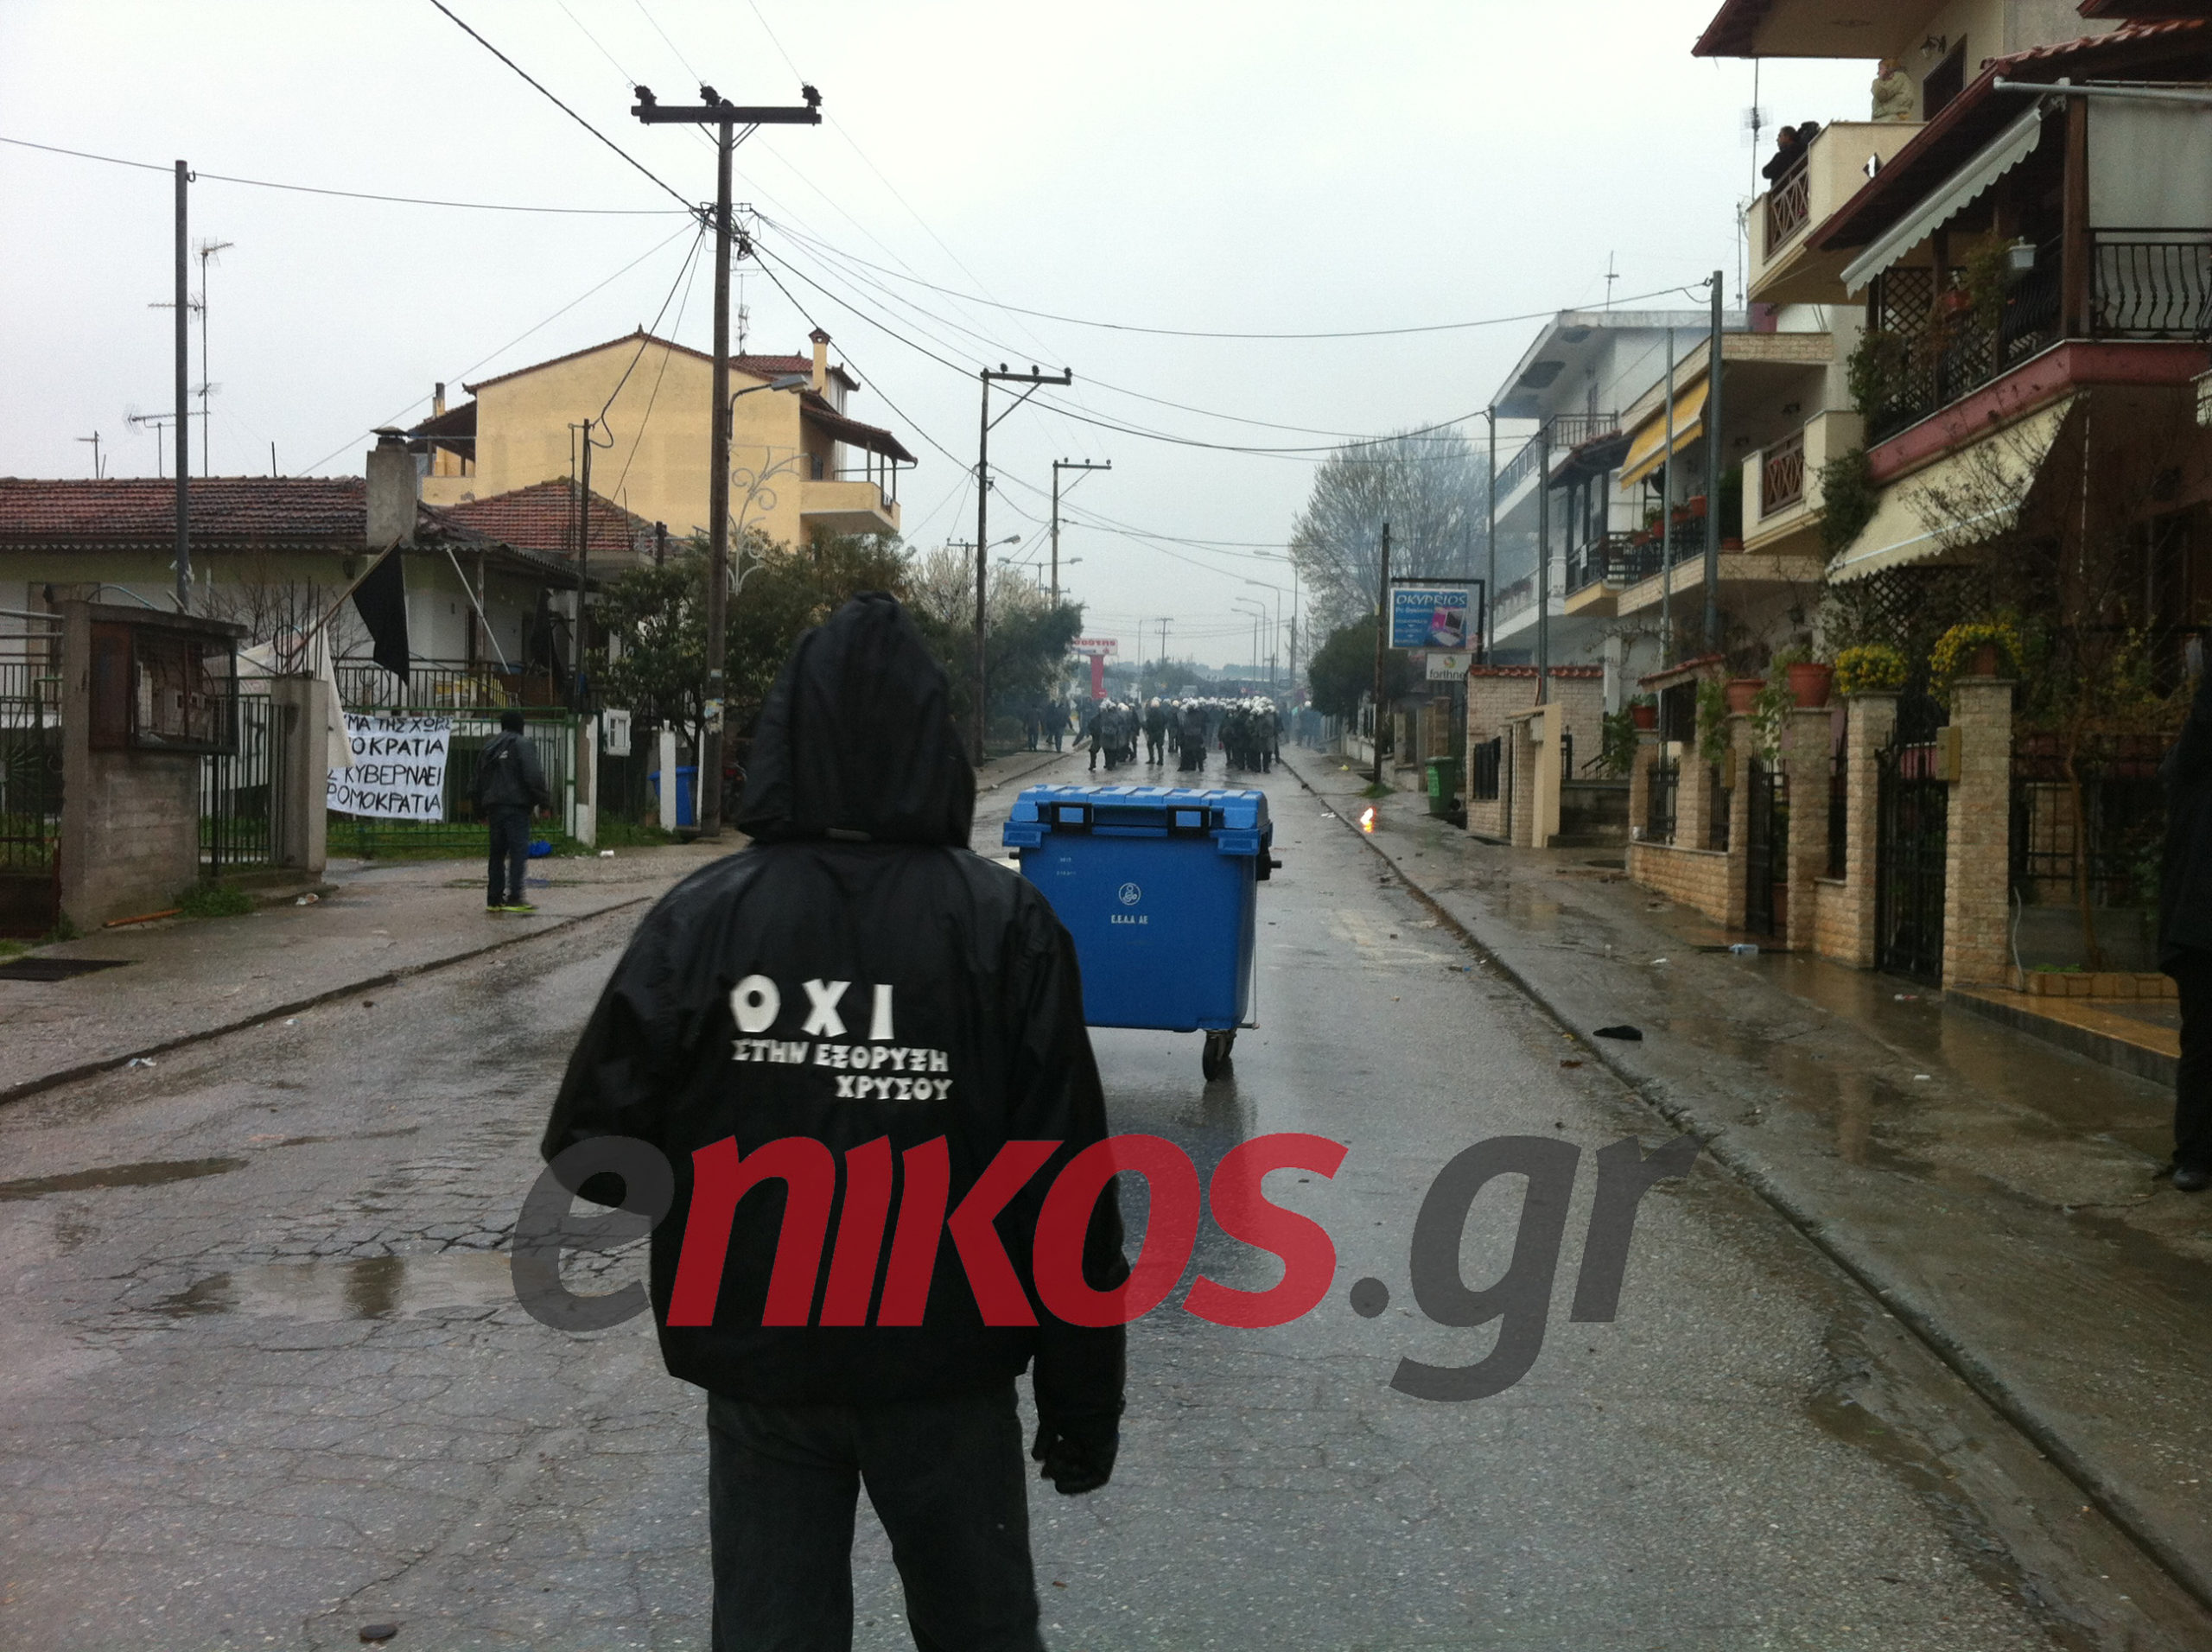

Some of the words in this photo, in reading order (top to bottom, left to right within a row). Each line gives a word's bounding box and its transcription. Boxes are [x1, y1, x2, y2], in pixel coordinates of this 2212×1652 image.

[1429, 668, 1467, 679] forthne
[344, 714, 371, 731] ΜΑ
[374, 717, 407, 733] ΤΗΣ
[349, 736, 444, 757] ΟΚΡΑΤΙΑ
[327, 783, 442, 814] ΡΟΜΟΚΡΑΤΙΑ
[730, 974, 894, 1040] ΟΧΙ
[731, 1038, 810, 1064] ΣΤΗΝ
[835, 1075, 953, 1101] ΧΡΥΣΟΥ
